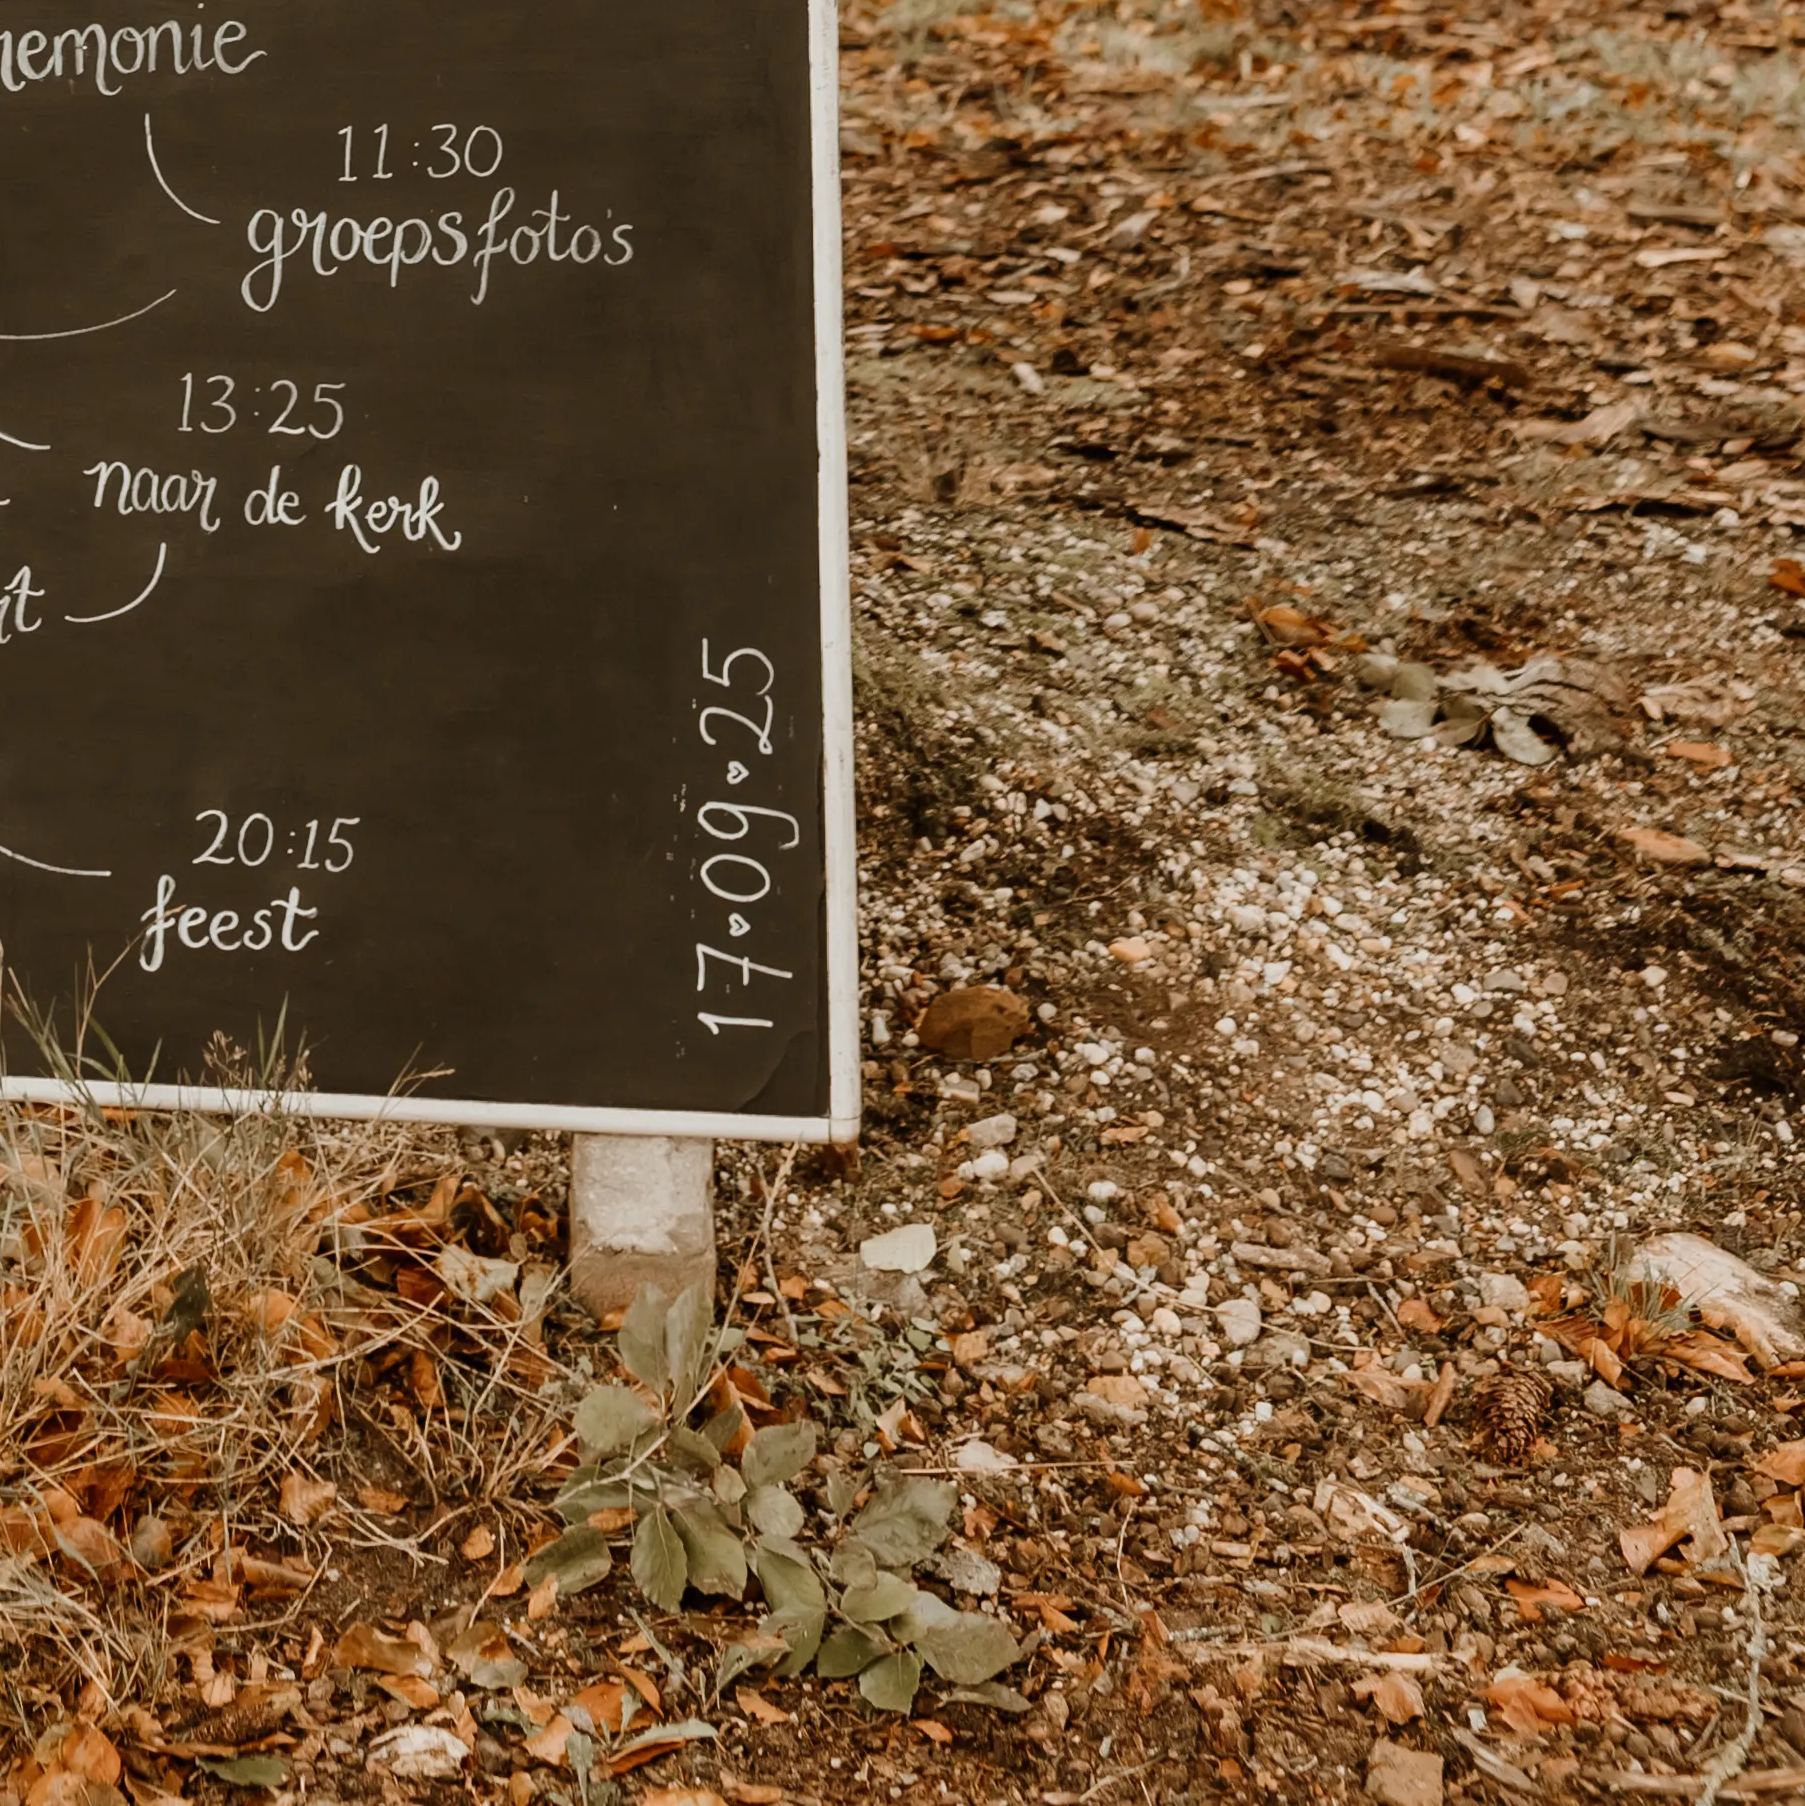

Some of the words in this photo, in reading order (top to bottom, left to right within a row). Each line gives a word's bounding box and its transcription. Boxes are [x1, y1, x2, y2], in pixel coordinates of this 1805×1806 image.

[336, 122, 504, 183] 11:30
[176, 371, 347, 441] 13:25
[81, 456, 222, 533] naar
[242, 463, 307, 527] de
[323, 463, 464, 553] kerk
[191, 809, 362, 874] 20:15
[138, 874, 321, 973] feest
